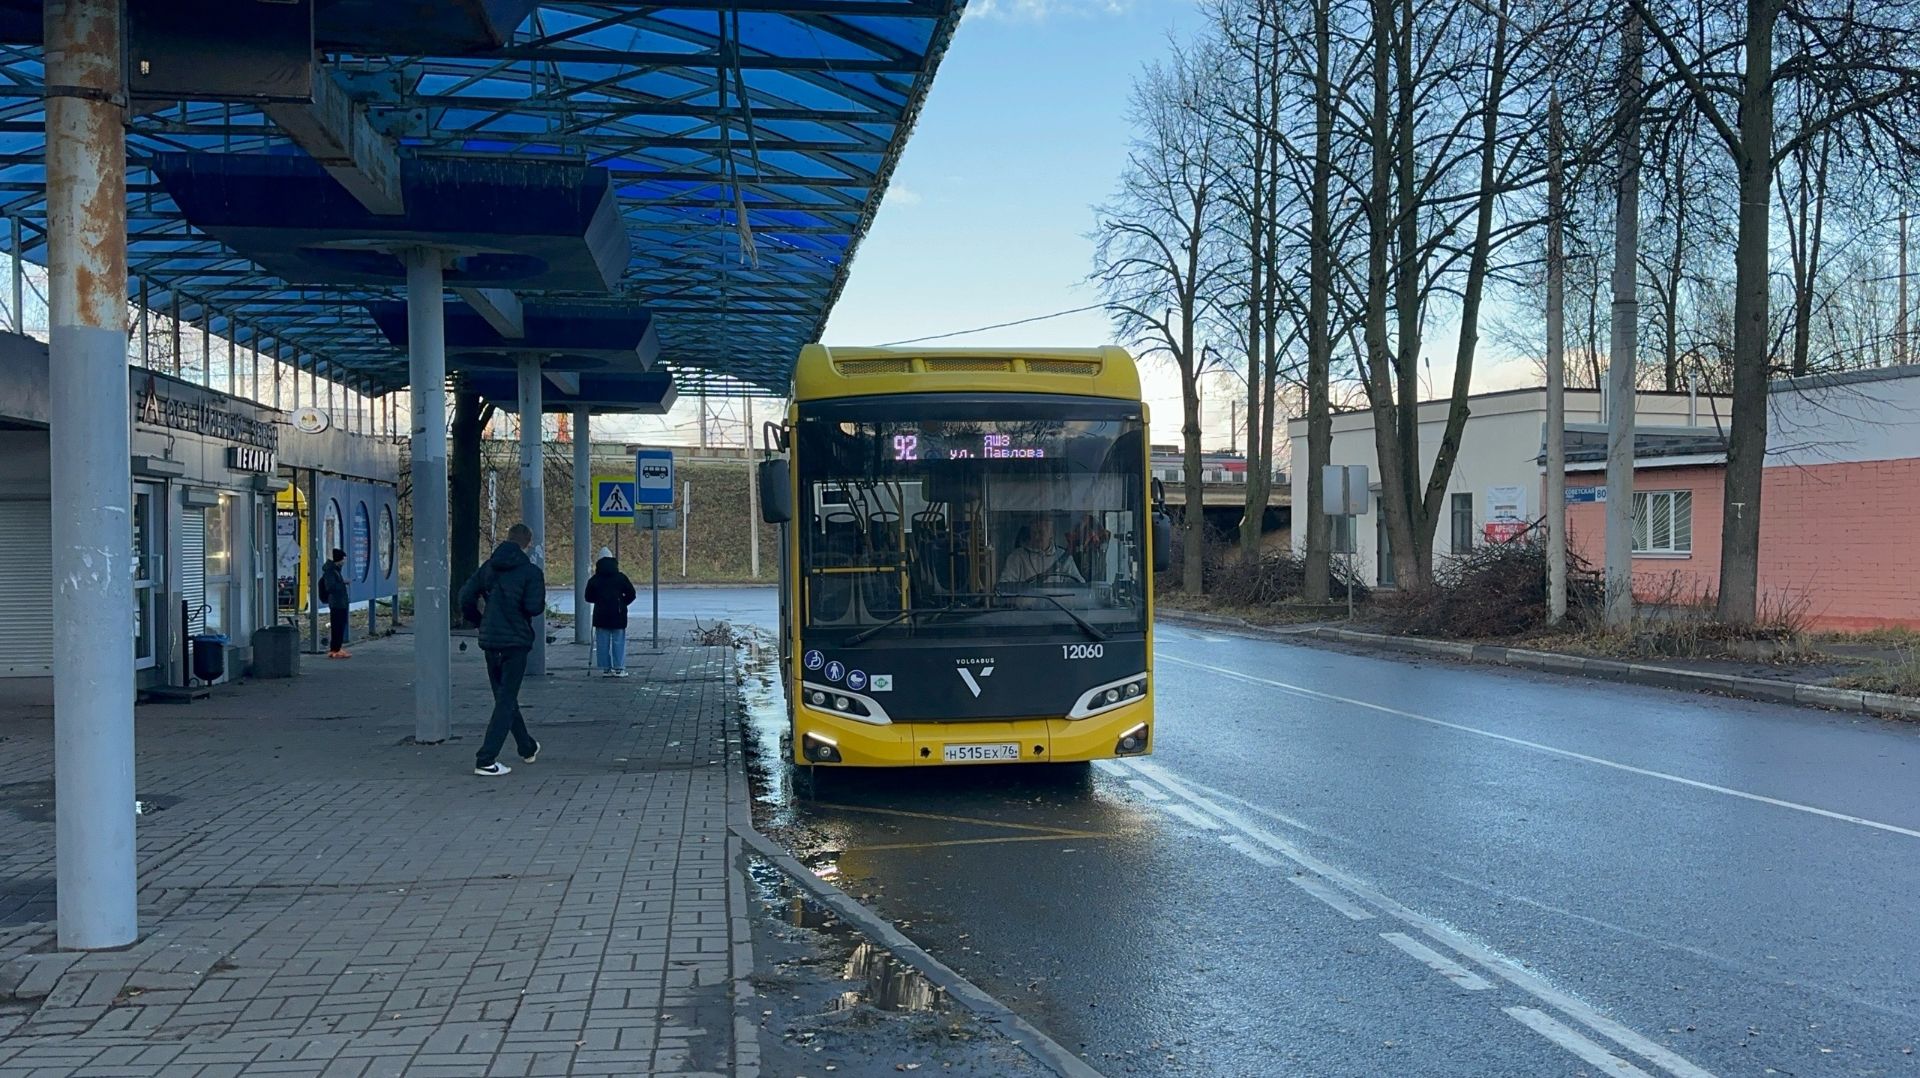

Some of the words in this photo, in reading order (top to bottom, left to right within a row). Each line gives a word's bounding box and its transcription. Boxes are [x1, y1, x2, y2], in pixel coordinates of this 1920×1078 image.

[984, 435, 1010, 447] ЯШЗ
[893, 435, 917, 460] 92
[950, 449, 975, 459] ул.
[984, 447, 1044, 459] Павлова
[236, 447, 275, 473] ПЕКАРНЯ
[1596, 489, 1607, 498] 80
[1062, 644, 1104, 660] 12060
[955, 657, 995, 665] VOLGABUS
[1002, 745, 1015, 756] 76
